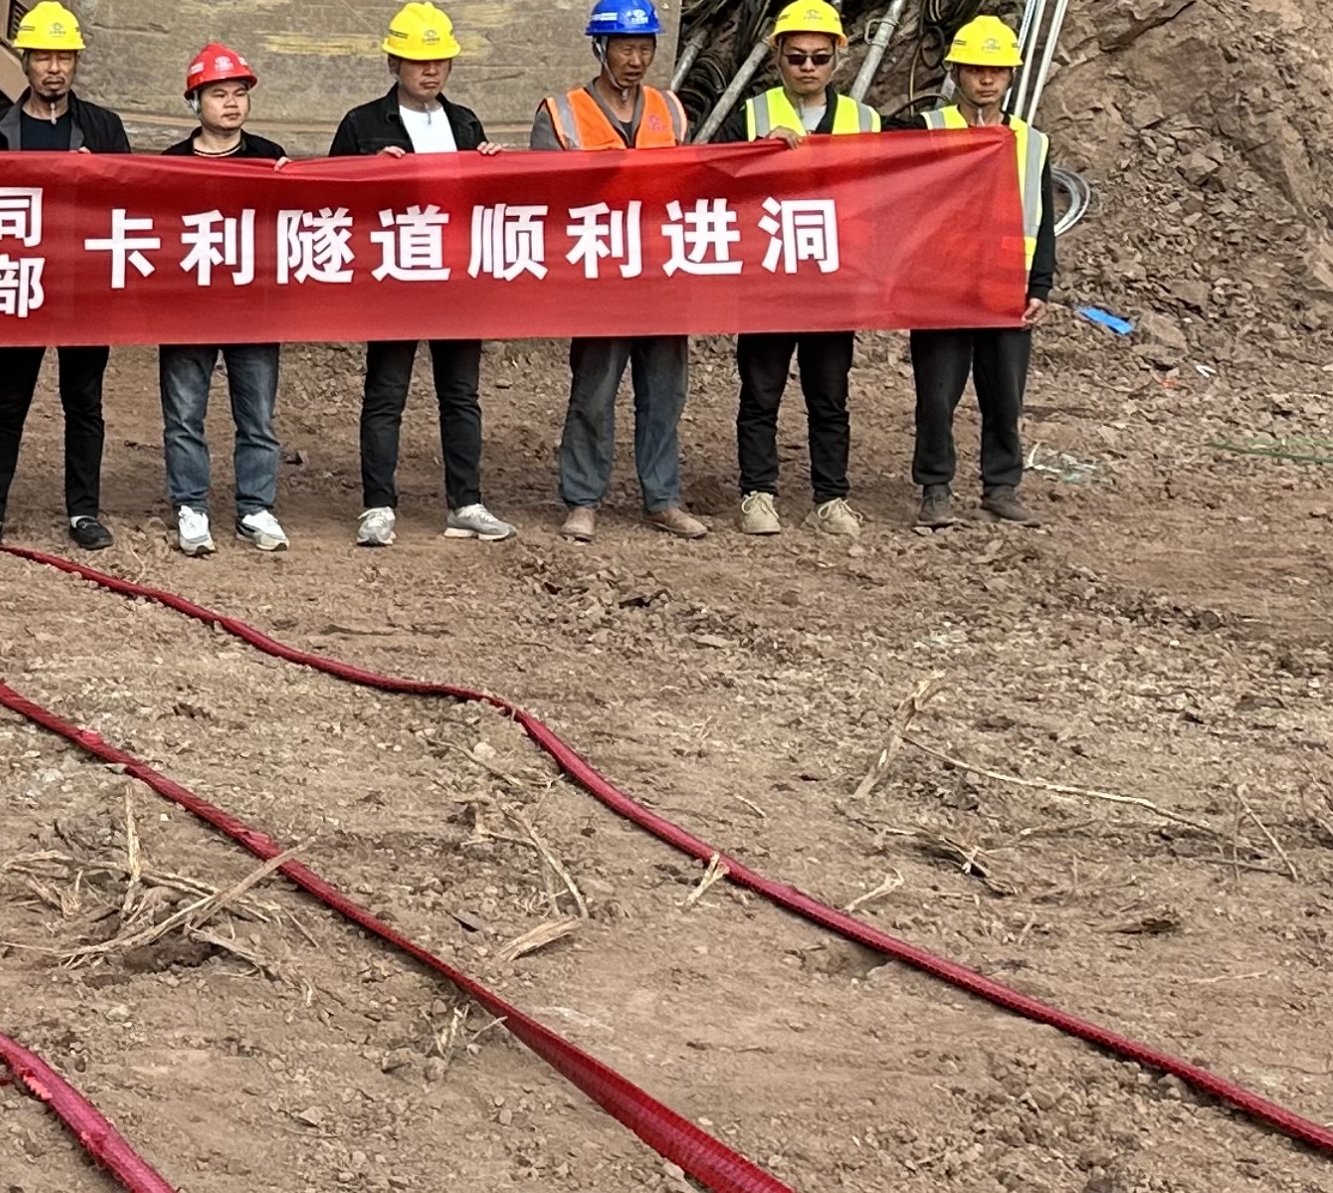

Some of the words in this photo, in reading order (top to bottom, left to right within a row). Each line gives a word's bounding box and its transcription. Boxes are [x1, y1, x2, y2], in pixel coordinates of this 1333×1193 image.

[85, 196, 842, 291] 卡利隧道顺利进洞
